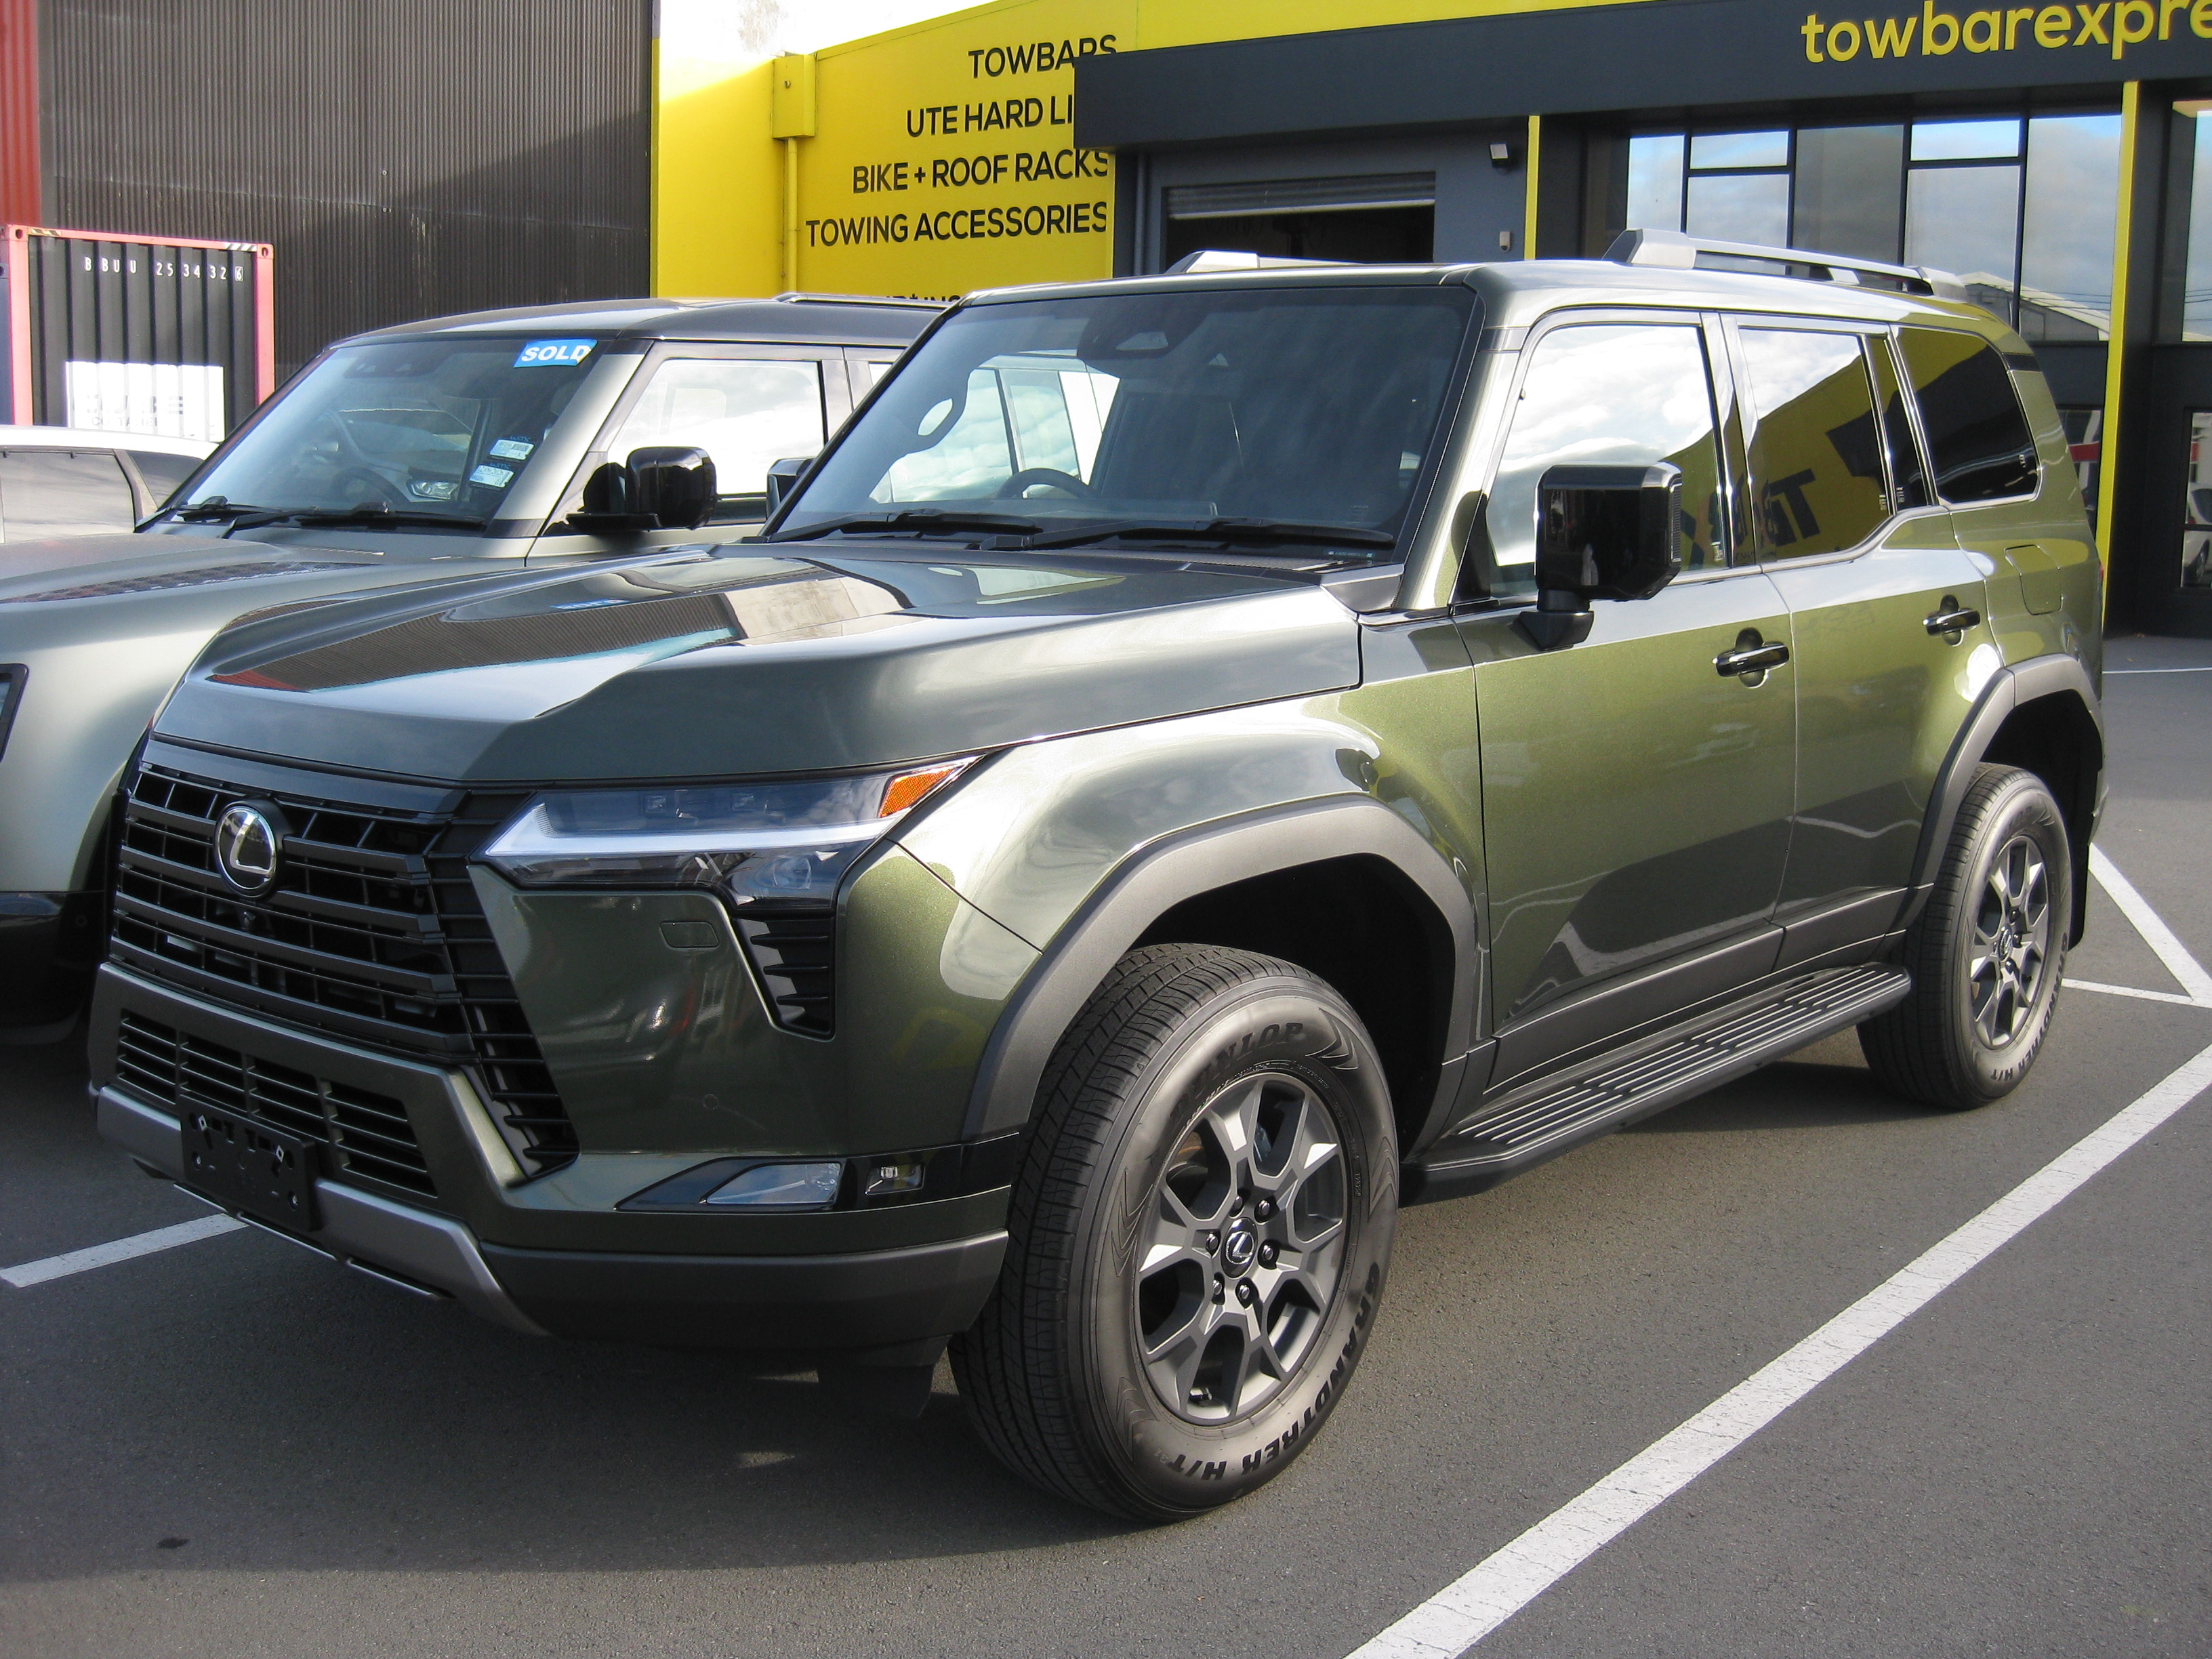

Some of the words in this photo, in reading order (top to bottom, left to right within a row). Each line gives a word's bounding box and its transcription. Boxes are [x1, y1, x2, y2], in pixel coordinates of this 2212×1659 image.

[907, 105, 958, 137] UTE
[964, 98, 1044, 134] HARD
[1050, 94, 1073, 125] LI
[853, 162, 908, 194] BIKE
[932, 155, 1009, 188] ROOF
[1015, 148, 1108, 182] RACKS
[806, 213, 909, 247] TOWING
[914, 201, 1107, 242] ACCESSORIES
[85, 256, 136, 274] BBUU
[520, 345, 592, 362] SOLD
[1242, 1262, 1380, 1476] GRANDTREK
[1167, 1454, 1227, 1481] H/T
